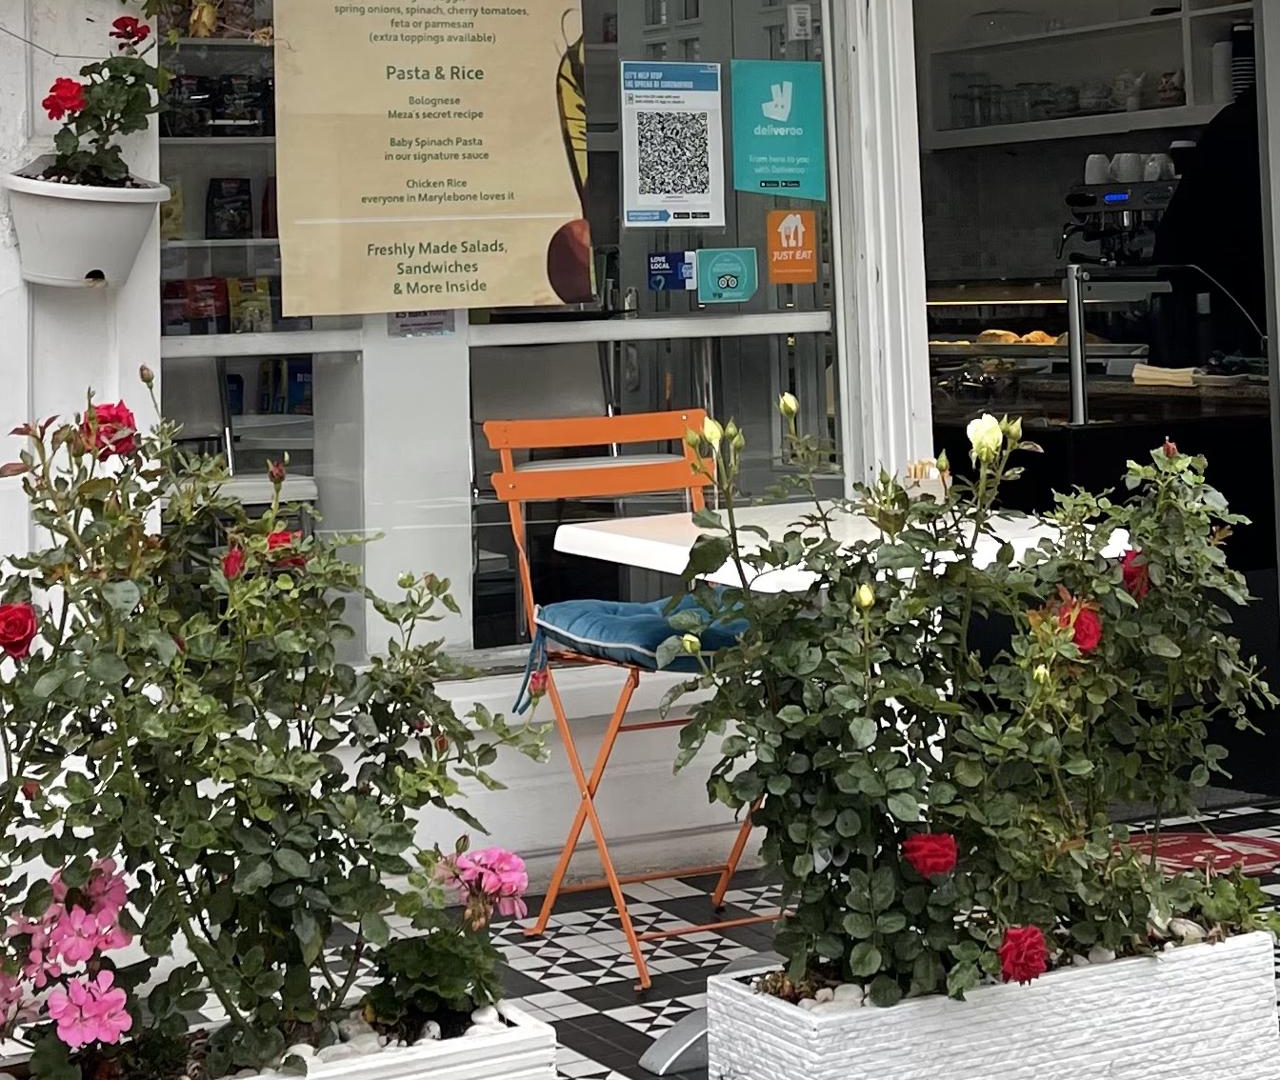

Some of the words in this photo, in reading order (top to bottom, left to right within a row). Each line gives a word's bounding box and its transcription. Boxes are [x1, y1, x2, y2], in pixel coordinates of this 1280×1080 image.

[334, 4, 366, 16] spring
[367, 5, 403, 16] onions,
[447, 6, 479, 18] cherry
[390, 19, 410, 29] feta
[412, 21, 422, 29] or
[424, 21, 474, 31] parmesan
[369, 33, 399, 44] (extra
[400, 33, 445, 45] toppings
[447, 33, 496, 44] available)
[386, 65, 431, 81] Pasta
[434, 66, 445, 80] &
[450, 65, 485, 80] Rice
[408, 95, 461, 107] Bolognese
[387, 109, 420, 119] Meza's
[422, 110, 451, 119] secret
[453, 109, 484, 121] recipe
[753, 123, 804, 136] deliveroo
[389, 137, 413, 149] Baby
[414, 137, 454, 149] Spinach
[455, 136, 483, 146] Pasta
[384, 152, 394, 161] in
[395, 152, 411, 161] our
[413, 151, 460, 163] signature
[461, 152, 490, 160] sauce
[406, 179, 445, 189] Chicken
[447, 178, 468, 188] Rice
[361, 195, 406, 206] everyone
[406, 194, 416, 203] in
[418, 191, 478, 205] Marylebone
[479, 191, 506, 201] loves
[507, 191, 515, 200] it
[366, 241, 415, 258] Freshly
[418, 240, 458, 256] Made
[772, 250, 794, 262] JUST
[795, 250, 813, 260] EAT
[396, 260, 479, 276] Sandwiches
[650, 262, 670, 270] LOCAL
[393, 281, 403, 296] &
[406, 280, 443, 295] More
[446, 279, 487, 294] Inside
